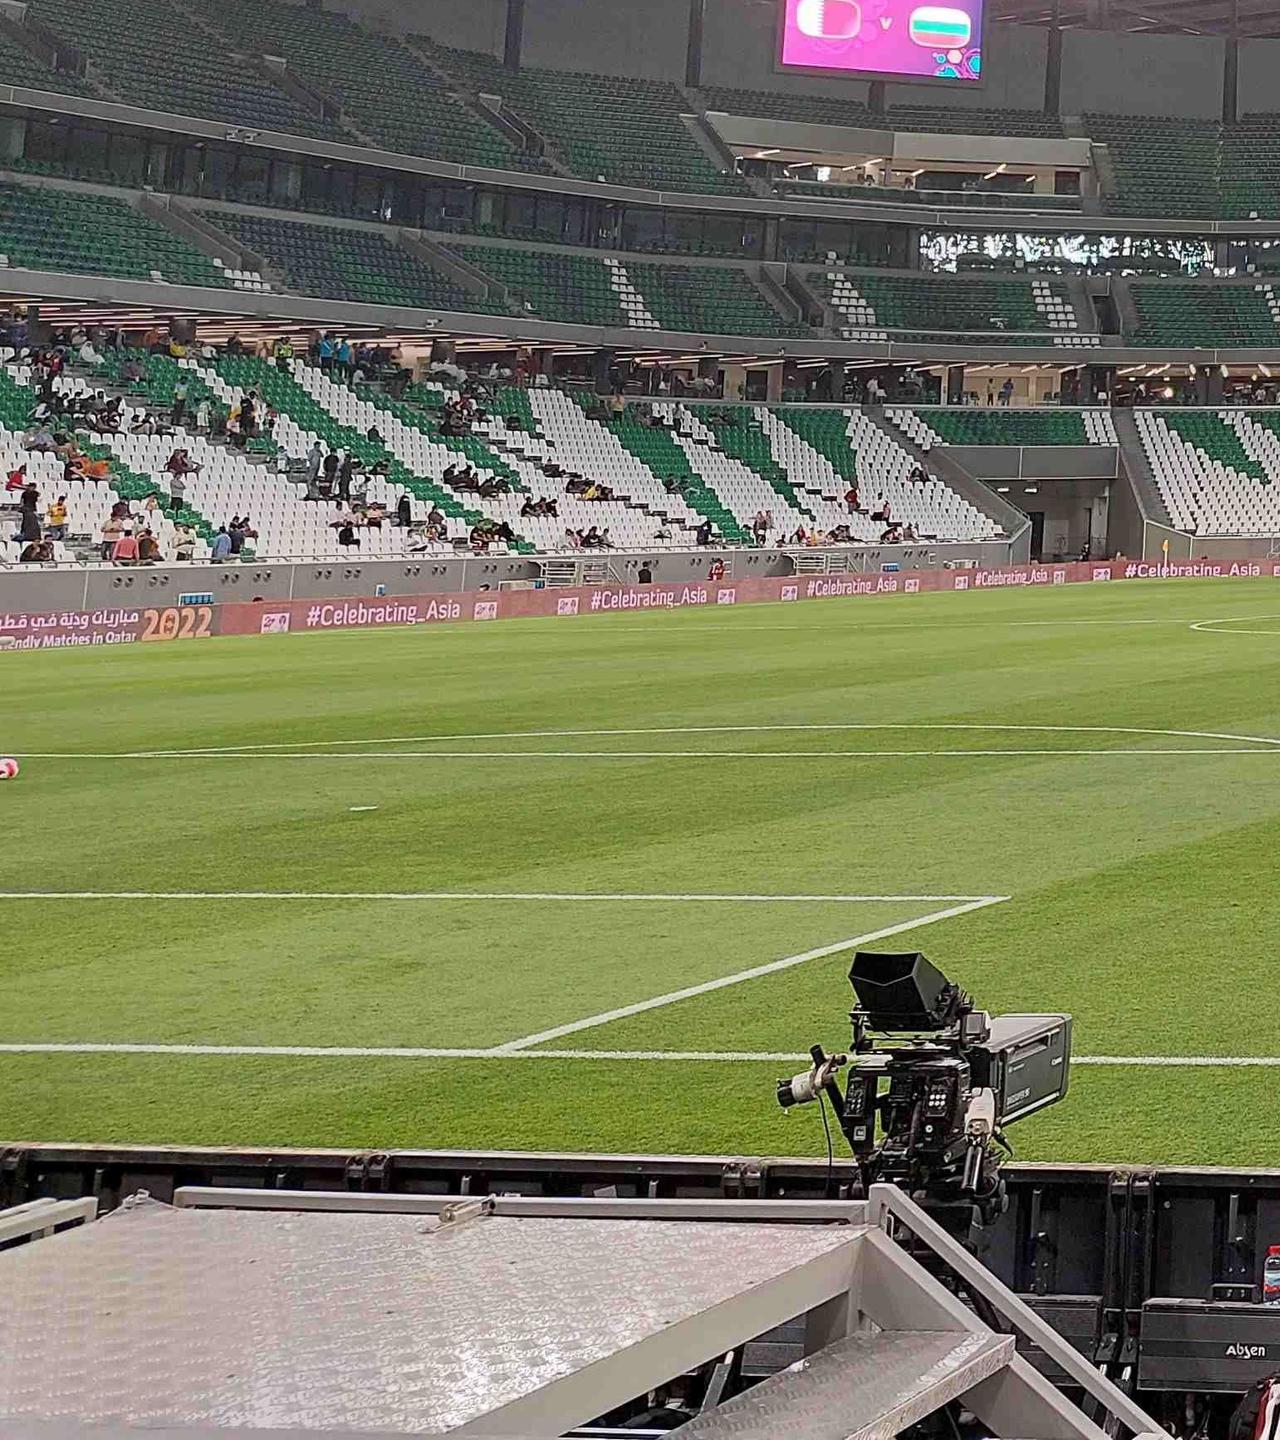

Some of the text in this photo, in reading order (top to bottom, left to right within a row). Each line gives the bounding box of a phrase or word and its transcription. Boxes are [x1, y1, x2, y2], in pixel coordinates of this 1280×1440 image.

[1125, 563, 1260, 577] #Celebrating_Asia
[807, 576, 897, 597] #Celebrating_Asia
[591, 587, 707, 610] #Celebrating_Asia
[30, 613, 57, 631] في
[92, 610, 139, 628] مباريات
[306, 600, 460, 626] #Celebrating_Asia
[141, 607, 213, 641] 2022
[43, 633, 91, 648] Matches
[92, 631, 104, 644] in
[105, 631, 137, 643] Qatar
[1225, 1342, 1267, 1359] Absen
